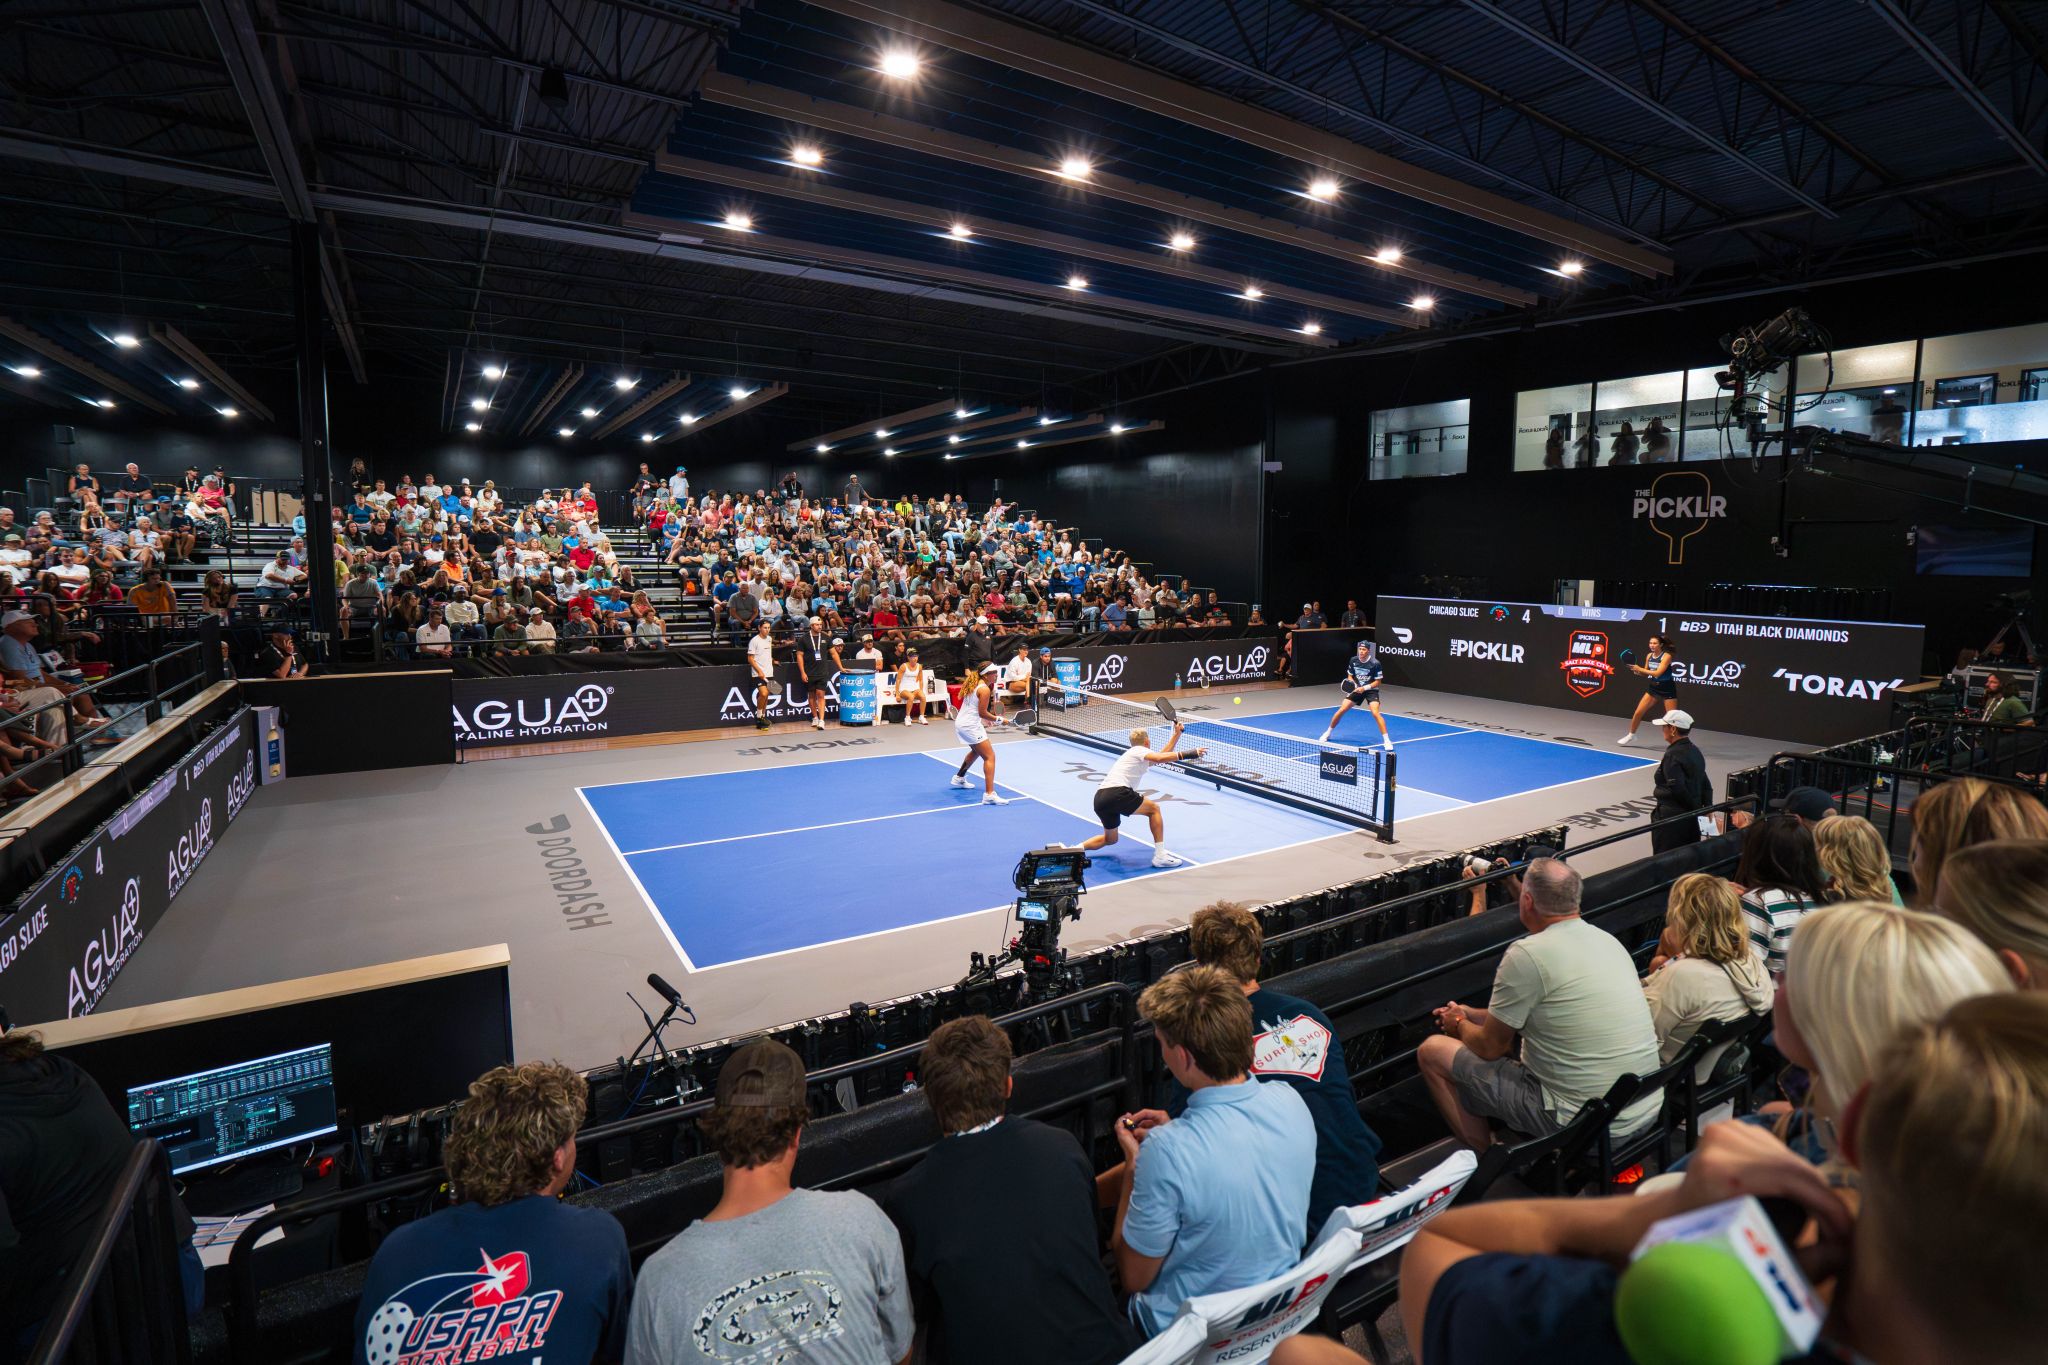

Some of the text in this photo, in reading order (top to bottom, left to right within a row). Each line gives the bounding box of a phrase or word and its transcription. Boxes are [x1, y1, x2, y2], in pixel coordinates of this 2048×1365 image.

[1635, 489, 1651, 497] THE
[1632, 495, 1728, 519] PICKLR
[1429, 605, 1459, 617] CHICAGO
[1459, 606, 1480, 618] SLICE
[1521, 609, 1531, 624] 4
[1558, 606, 1628, 620] 0 WINS 2
[1659, 617, 1667, 633] 1
[1715, 622, 1743, 637] UTAH
[1746, 624, 1782, 639] BLACK
[1785, 627, 1849, 643] DIAMONDS
[1379, 645, 1426, 658] DOORDASH
[1451, 638, 1525, 664] THE PICKLR
[1572, 641, 1605, 658] MLP
[1564, 659, 1578, 667] SALT
[1596, 662, 1610, 671] CITY
[1671, 661, 1734, 682] GUA
[1187, 671, 1266, 683] ALKLINE HYDRATION
[1689, 678, 1740, 689] HYDRATION
[455, 722, 608, 742] KALINE HYDRATION
[184, 769, 190, 791] 1
[95, 846, 104, 876] 4
[537, 836, 613, 931] DOORDASH
[19, 903, 49, 951] SLICE
[106, 929, 143, 985] HYDRATION
[1256, 1045, 1287, 1068] SURF
[398, 1289, 564, 1356] USAPA
[1216, 1315, 1303, 1364] RESERVED
